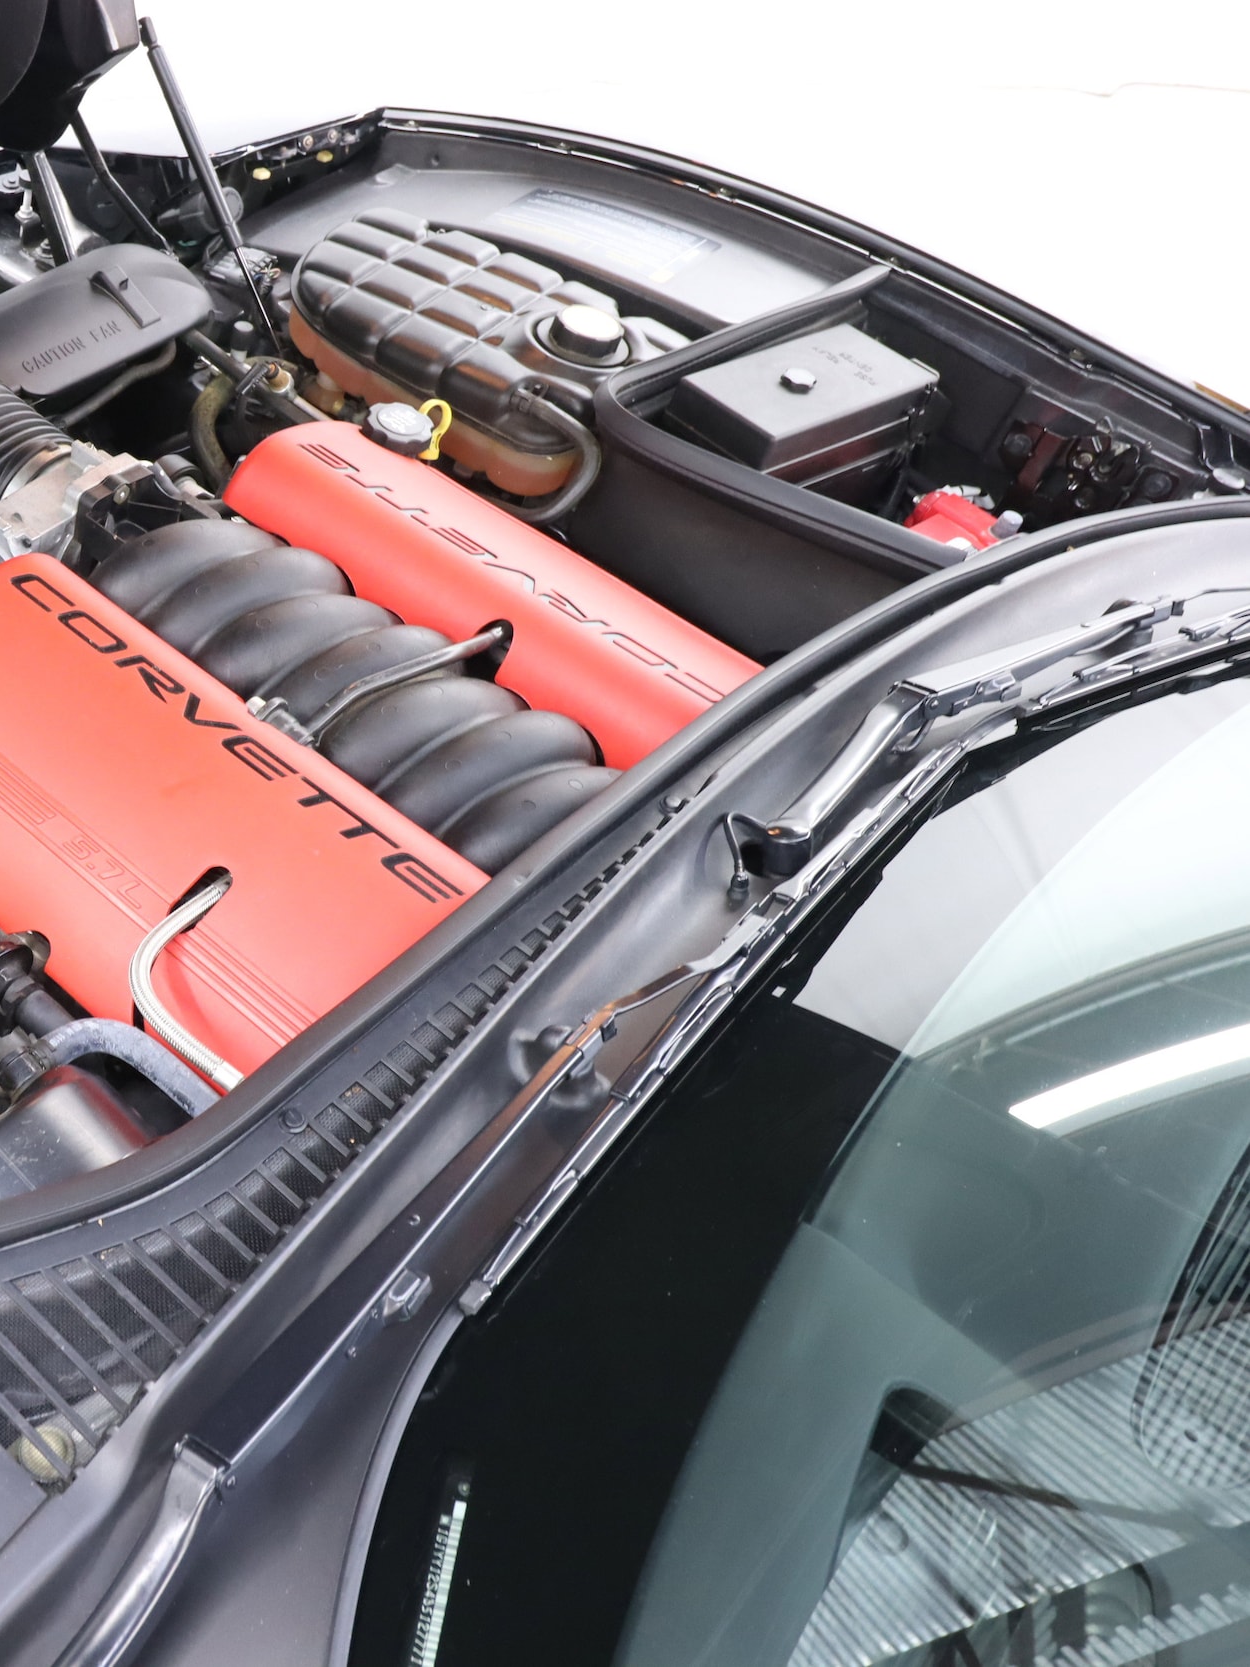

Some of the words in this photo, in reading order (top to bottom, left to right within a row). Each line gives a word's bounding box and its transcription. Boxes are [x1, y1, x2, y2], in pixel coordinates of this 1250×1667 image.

[21, 335, 87, 374] CAUTION
[89, 319, 122, 343] FAN
[298, 443, 726, 703] CORVETTE
[10, 573, 465, 903] CORVETTE
[62, 833, 142, 910] 5.7L
